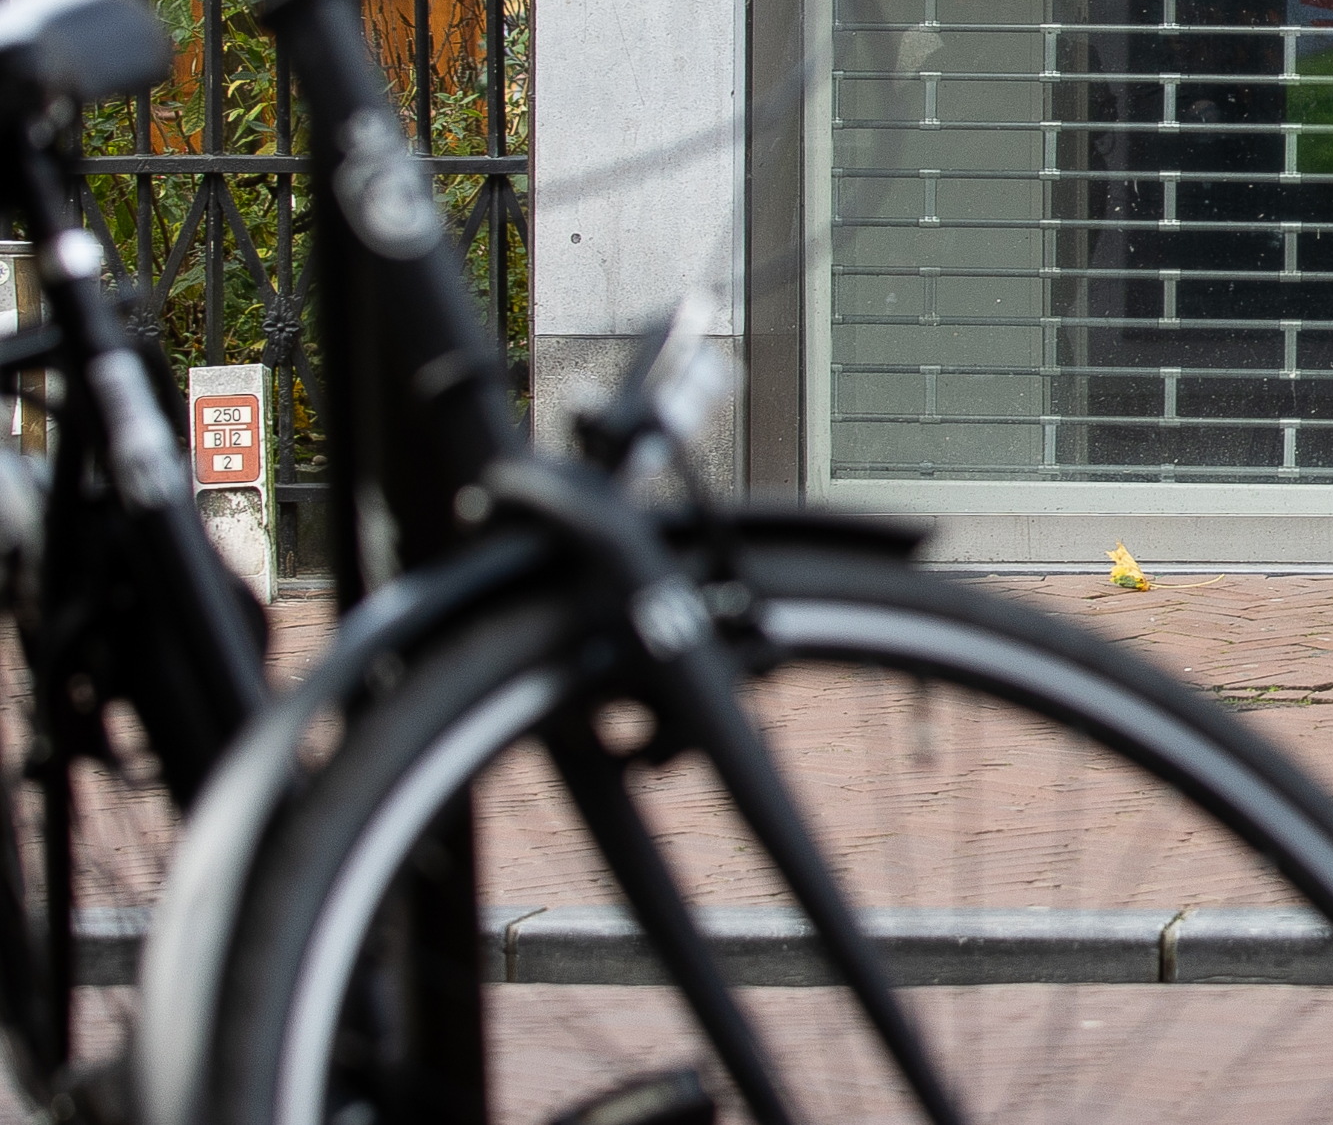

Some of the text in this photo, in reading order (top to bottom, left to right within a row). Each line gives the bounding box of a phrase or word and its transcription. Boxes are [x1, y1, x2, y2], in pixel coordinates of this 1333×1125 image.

[213, 408, 242, 423] 250
[214, 432, 242, 446] B 2
[223, 456, 232, 470] 2
